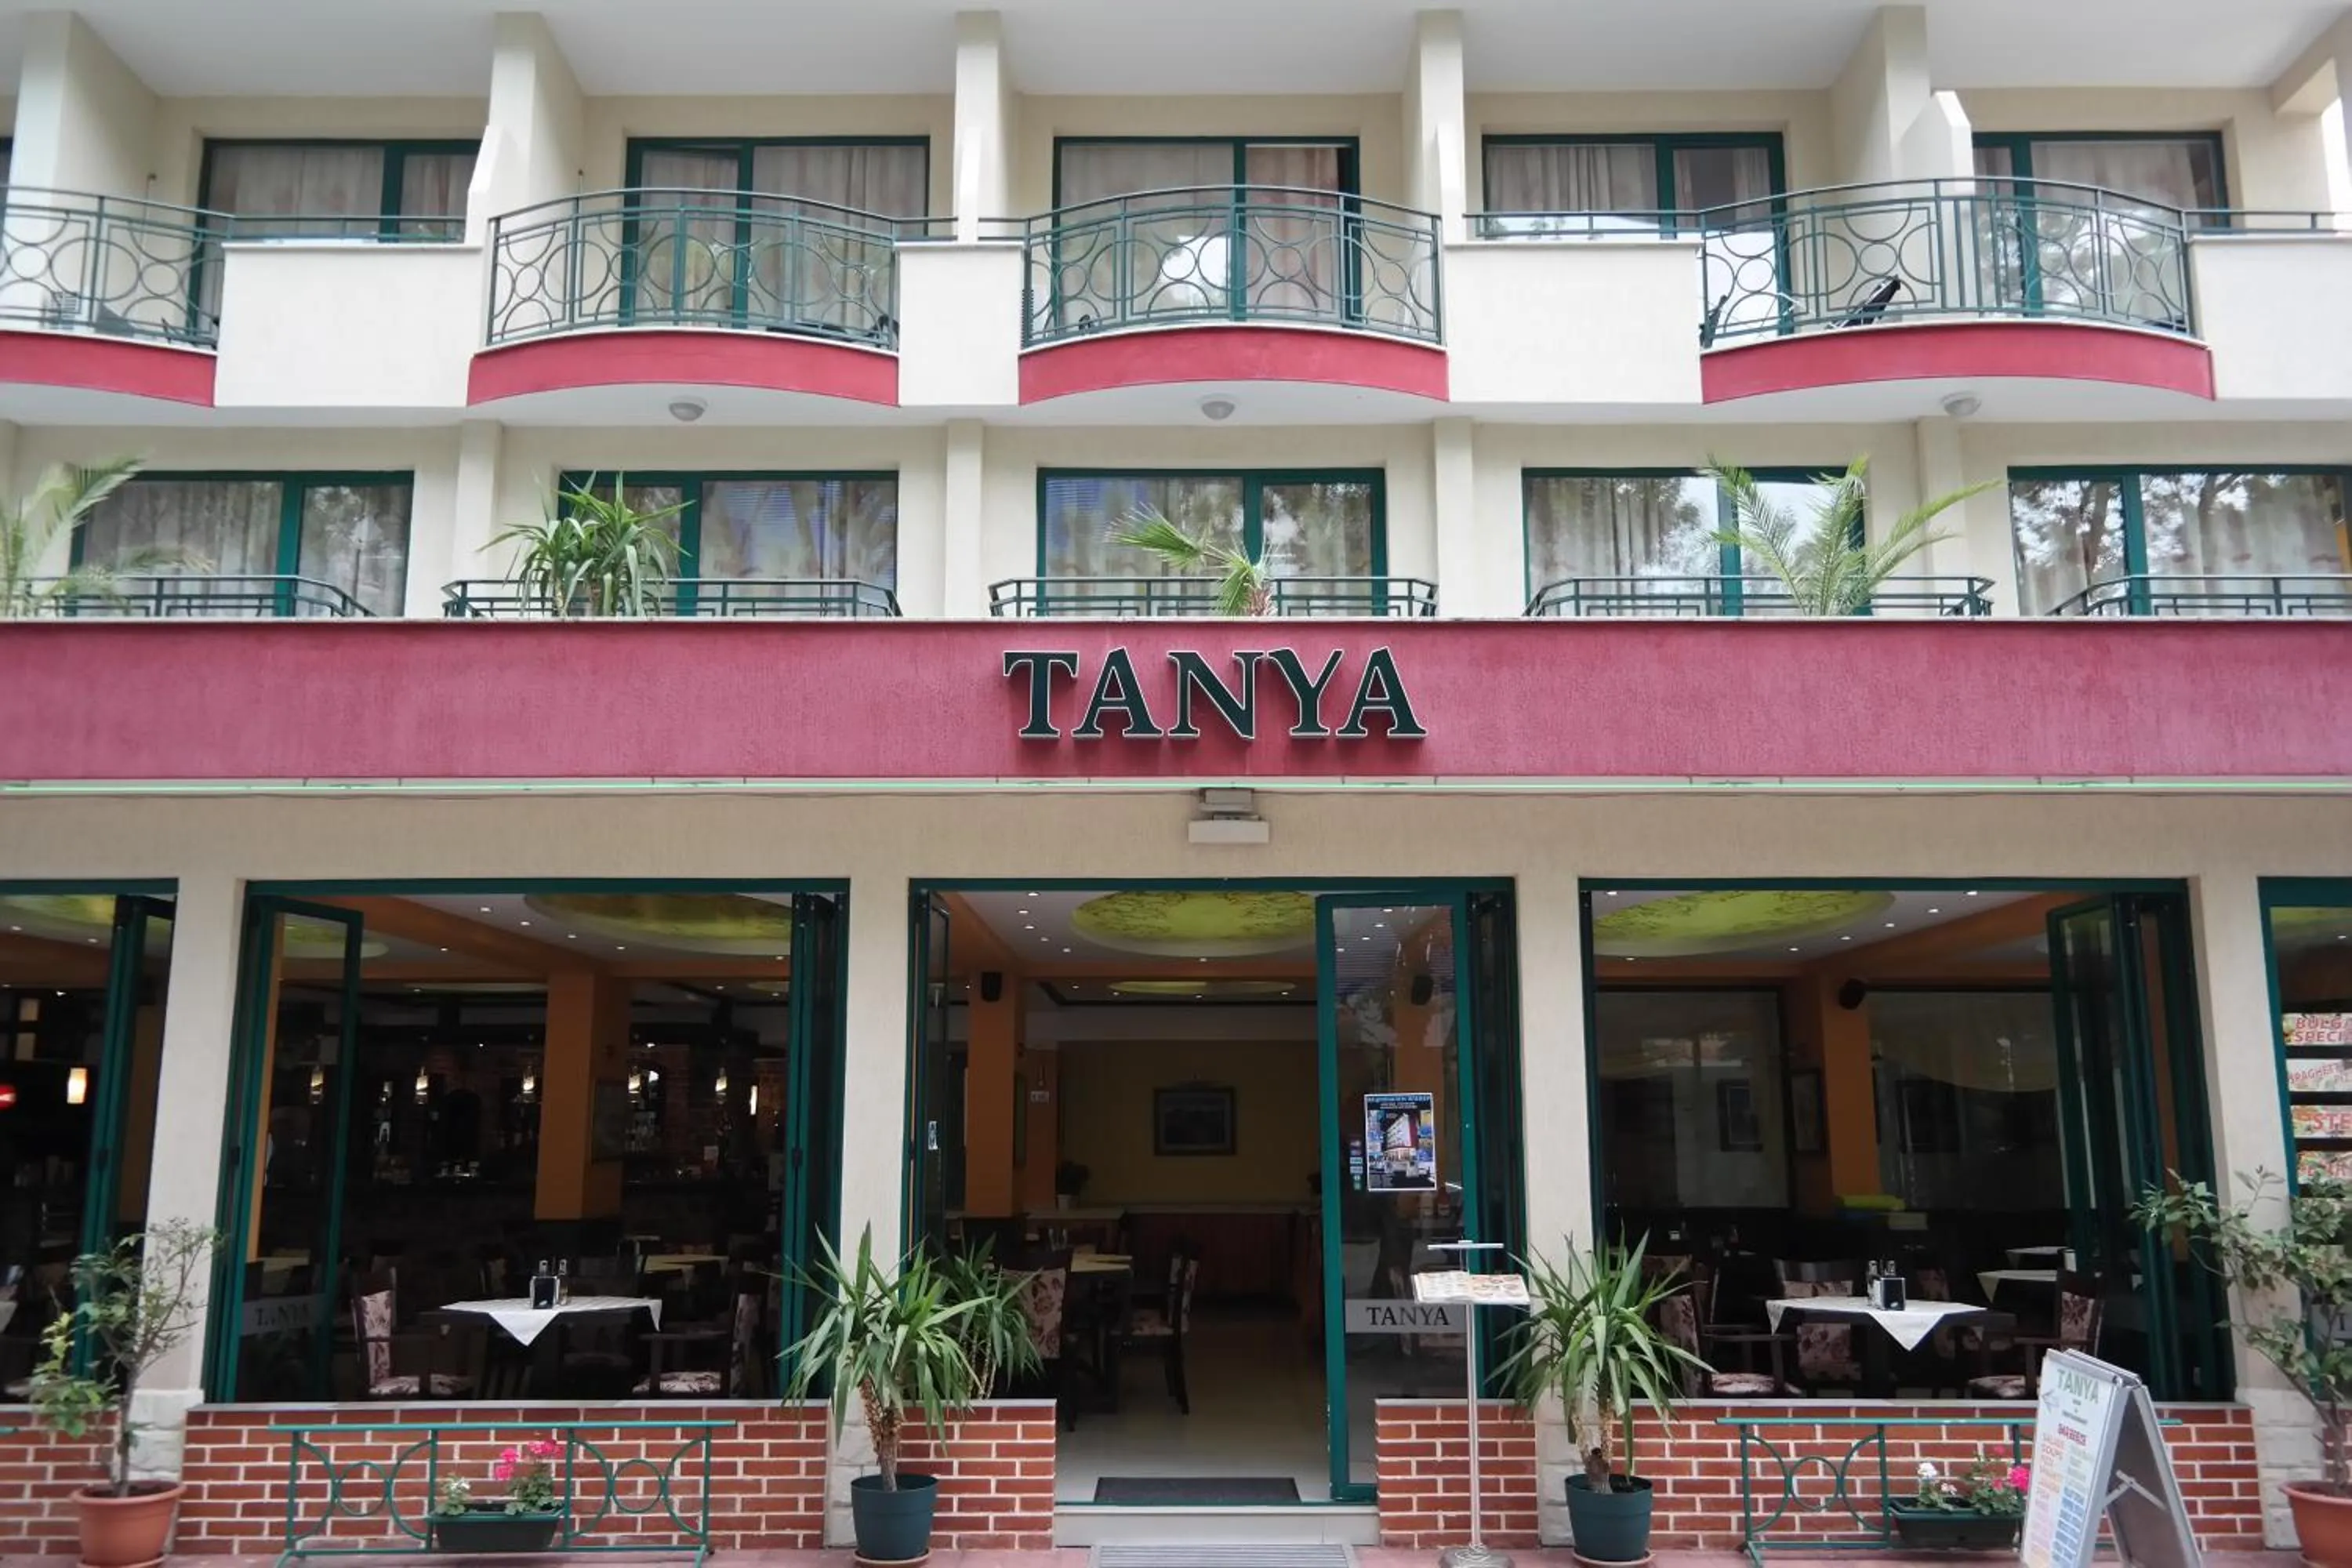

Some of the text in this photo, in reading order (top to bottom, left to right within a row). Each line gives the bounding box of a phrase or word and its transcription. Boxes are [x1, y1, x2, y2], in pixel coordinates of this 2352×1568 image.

[1003, 646, 1428, 739] TANYA
[1366, 1306, 1450, 1326] TANYA
[2057, 1369, 2099, 1405] TANYA
